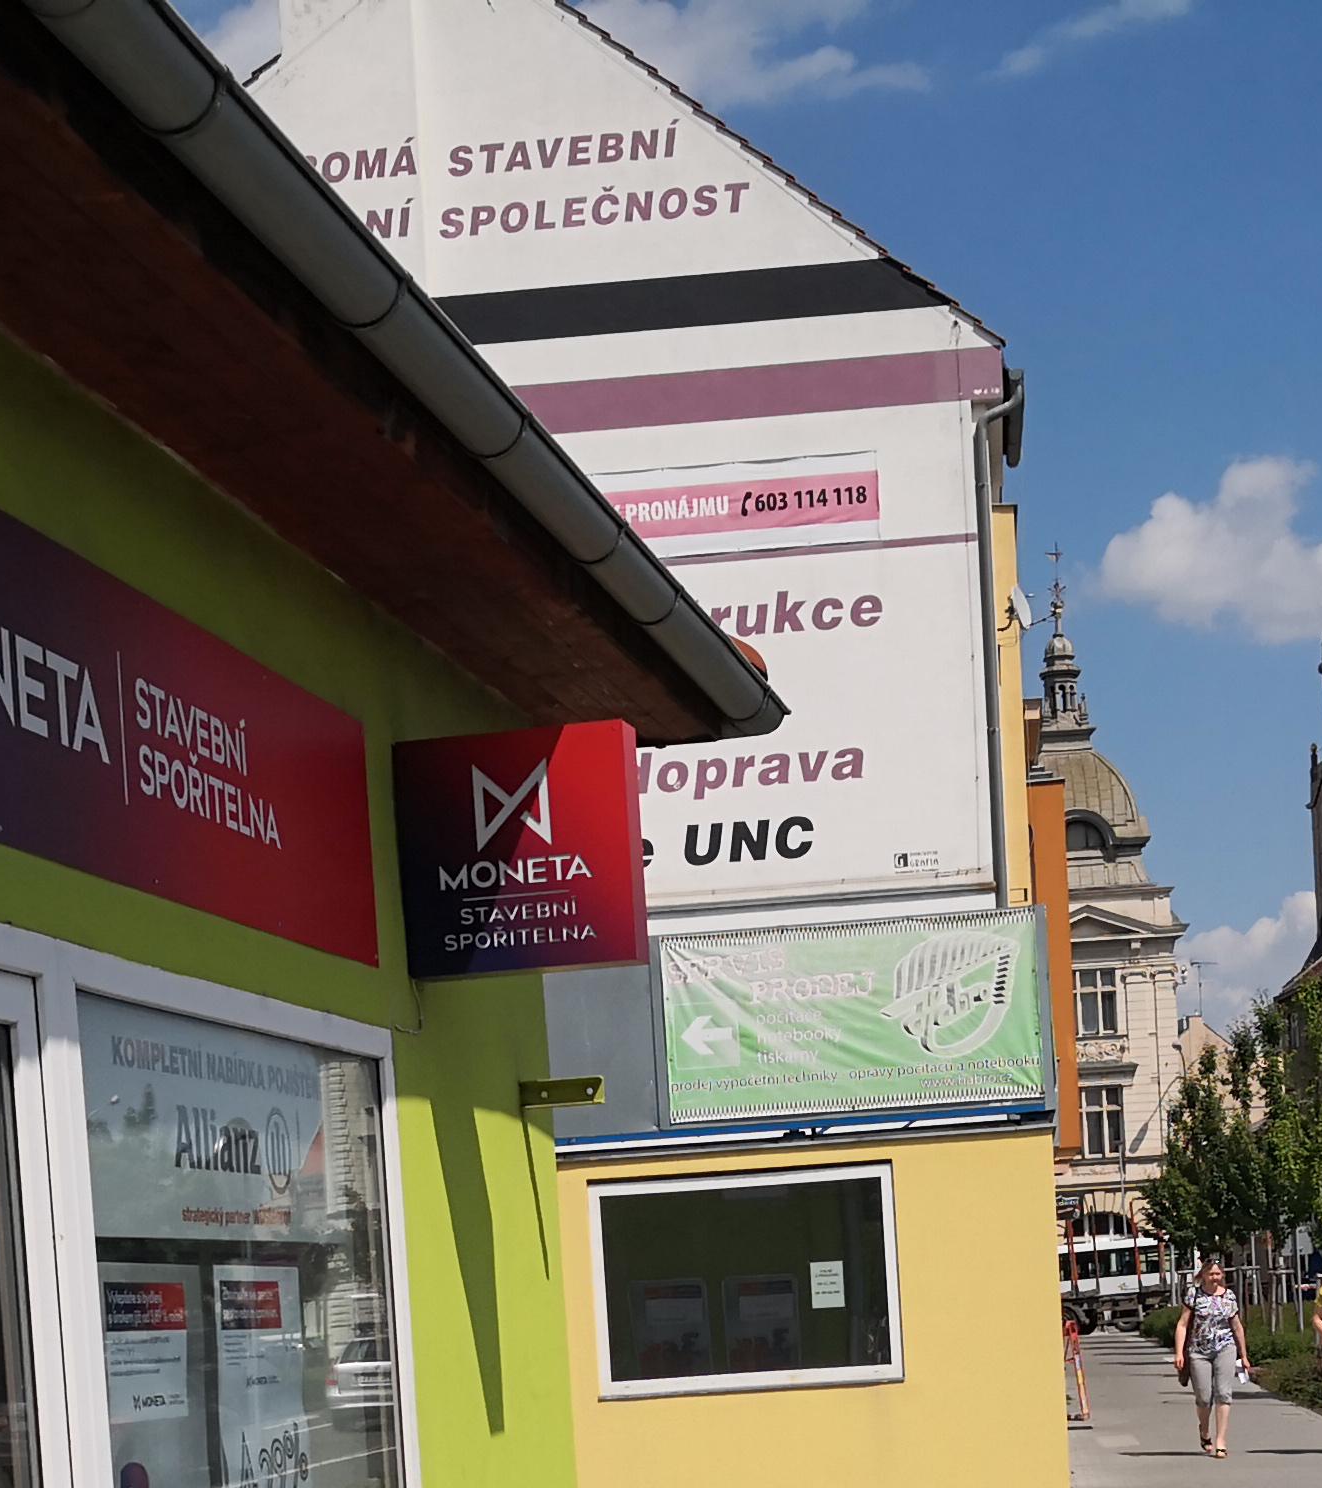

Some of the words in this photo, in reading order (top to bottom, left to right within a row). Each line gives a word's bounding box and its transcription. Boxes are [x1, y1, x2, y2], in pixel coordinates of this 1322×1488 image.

[448, 119, 679, 177] STAVEBNÍ
[439, 182, 750, 239] SPOLEČNOST
[626, 495, 729, 524] PRONÁJMU
[755, 491, 788, 513] 603
[793, 488, 826, 511] 114
[827, 485, 867, 509] 118
[134, 677, 248, 777] STAVEBNÍ
[138, 746, 282, 851] SPOŘITELNA
[683, 815, 814, 866] UNC
[439, 853, 592, 891] MONETA
[460, 898, 577, 925] STAVEBNÍ
[444, 924, 598, 952] SPOŘITELNA
[111, 1035, 203, 1079] KOMPLETNÍ
[671, 1078, 712, 1094] prodej
[175, 1105, 261, 1175] Allianz
